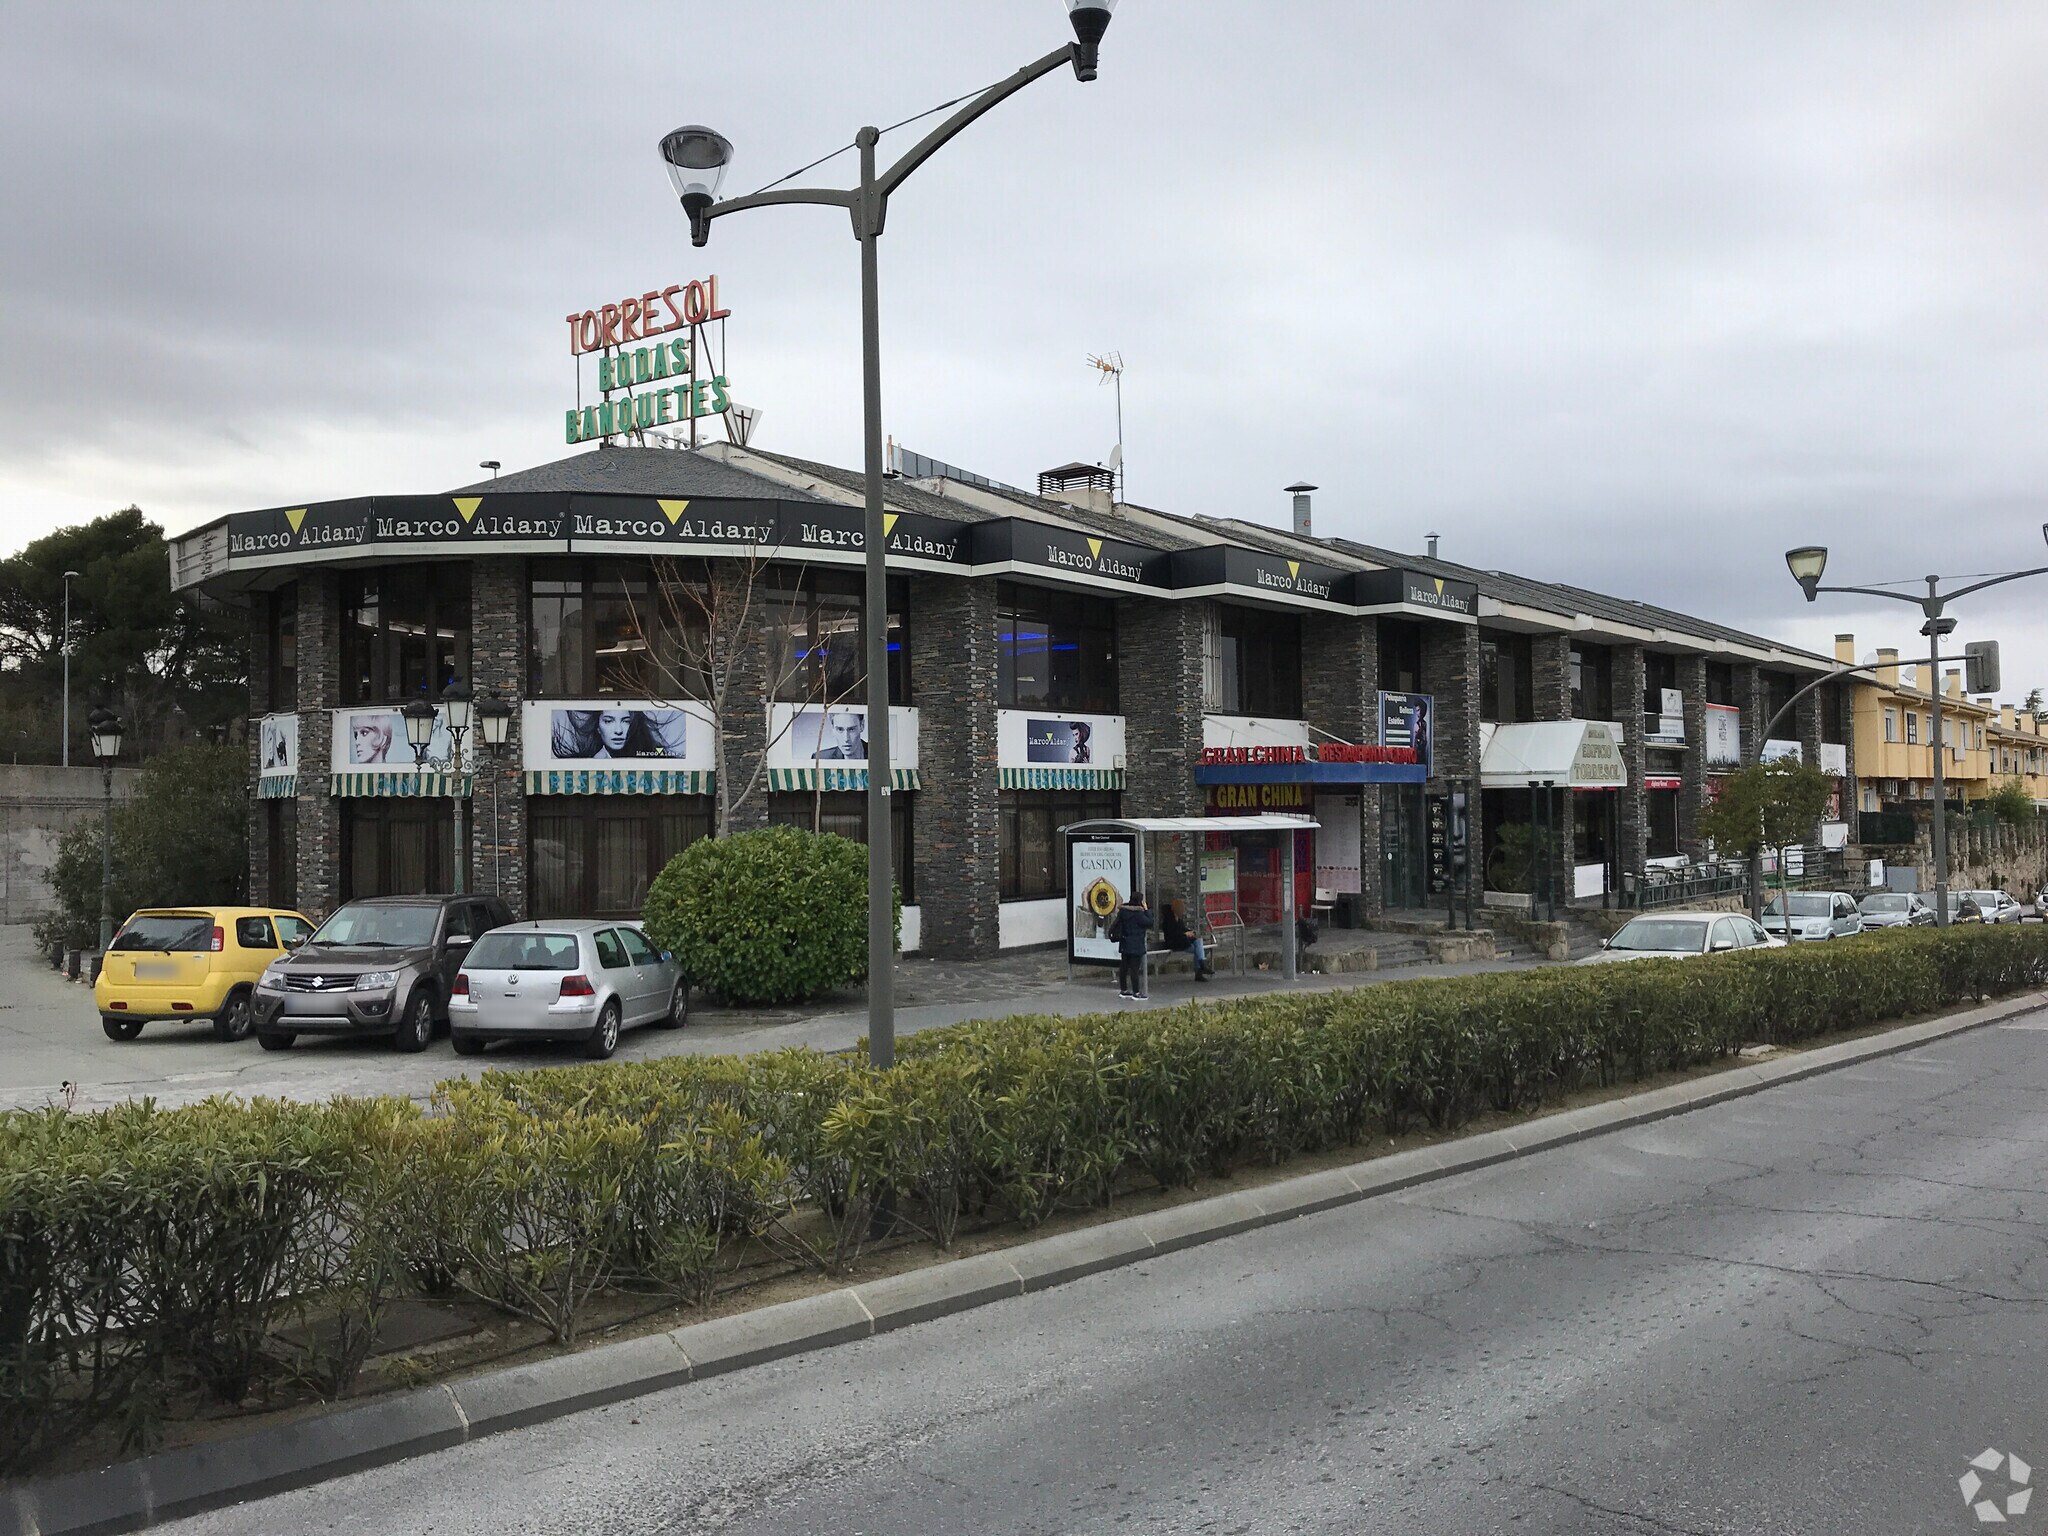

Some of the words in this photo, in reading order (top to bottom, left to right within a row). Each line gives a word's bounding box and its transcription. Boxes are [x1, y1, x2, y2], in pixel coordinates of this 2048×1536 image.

[566, 274, 731, 356] TORRESOL
[600, 338, 690, 392] BODAS
[566, 375, 731, 444] BANQUETES
[230, 532, 291, 553] Marco
[300, 525, 366, 543] Aldany
[376, 517, 460, 537] Marco
[472, 517, 562, 538] Aldany
[574, 515, 665, 536] Marco
[679, 520, 773, 543] Aldany
[801, 524, 866, 546] Marc
[890, 534, 957, 560] Aldany
[1047, 545, 1092, 569] Marco
[1099, 558, 1142, 581] Aldany
[1257, 569, 1292, 589] Marco
[1296, 578, 1330, 599] Aldany
[1410, 586, 1438, 604] Marco
[1202, 747, 1247, 765] GRAN
[1253, 745, 1305, 764] CHINA
[548, 774, 689, 790] RESTAURANTE
[1573, 762, 1621, 780] TORRESOL
[1217, 784, 1258, 808] GRAN
[1261, 784, 1303, 806] CHINA
[1081, 858, 1122, 871] CASINO
